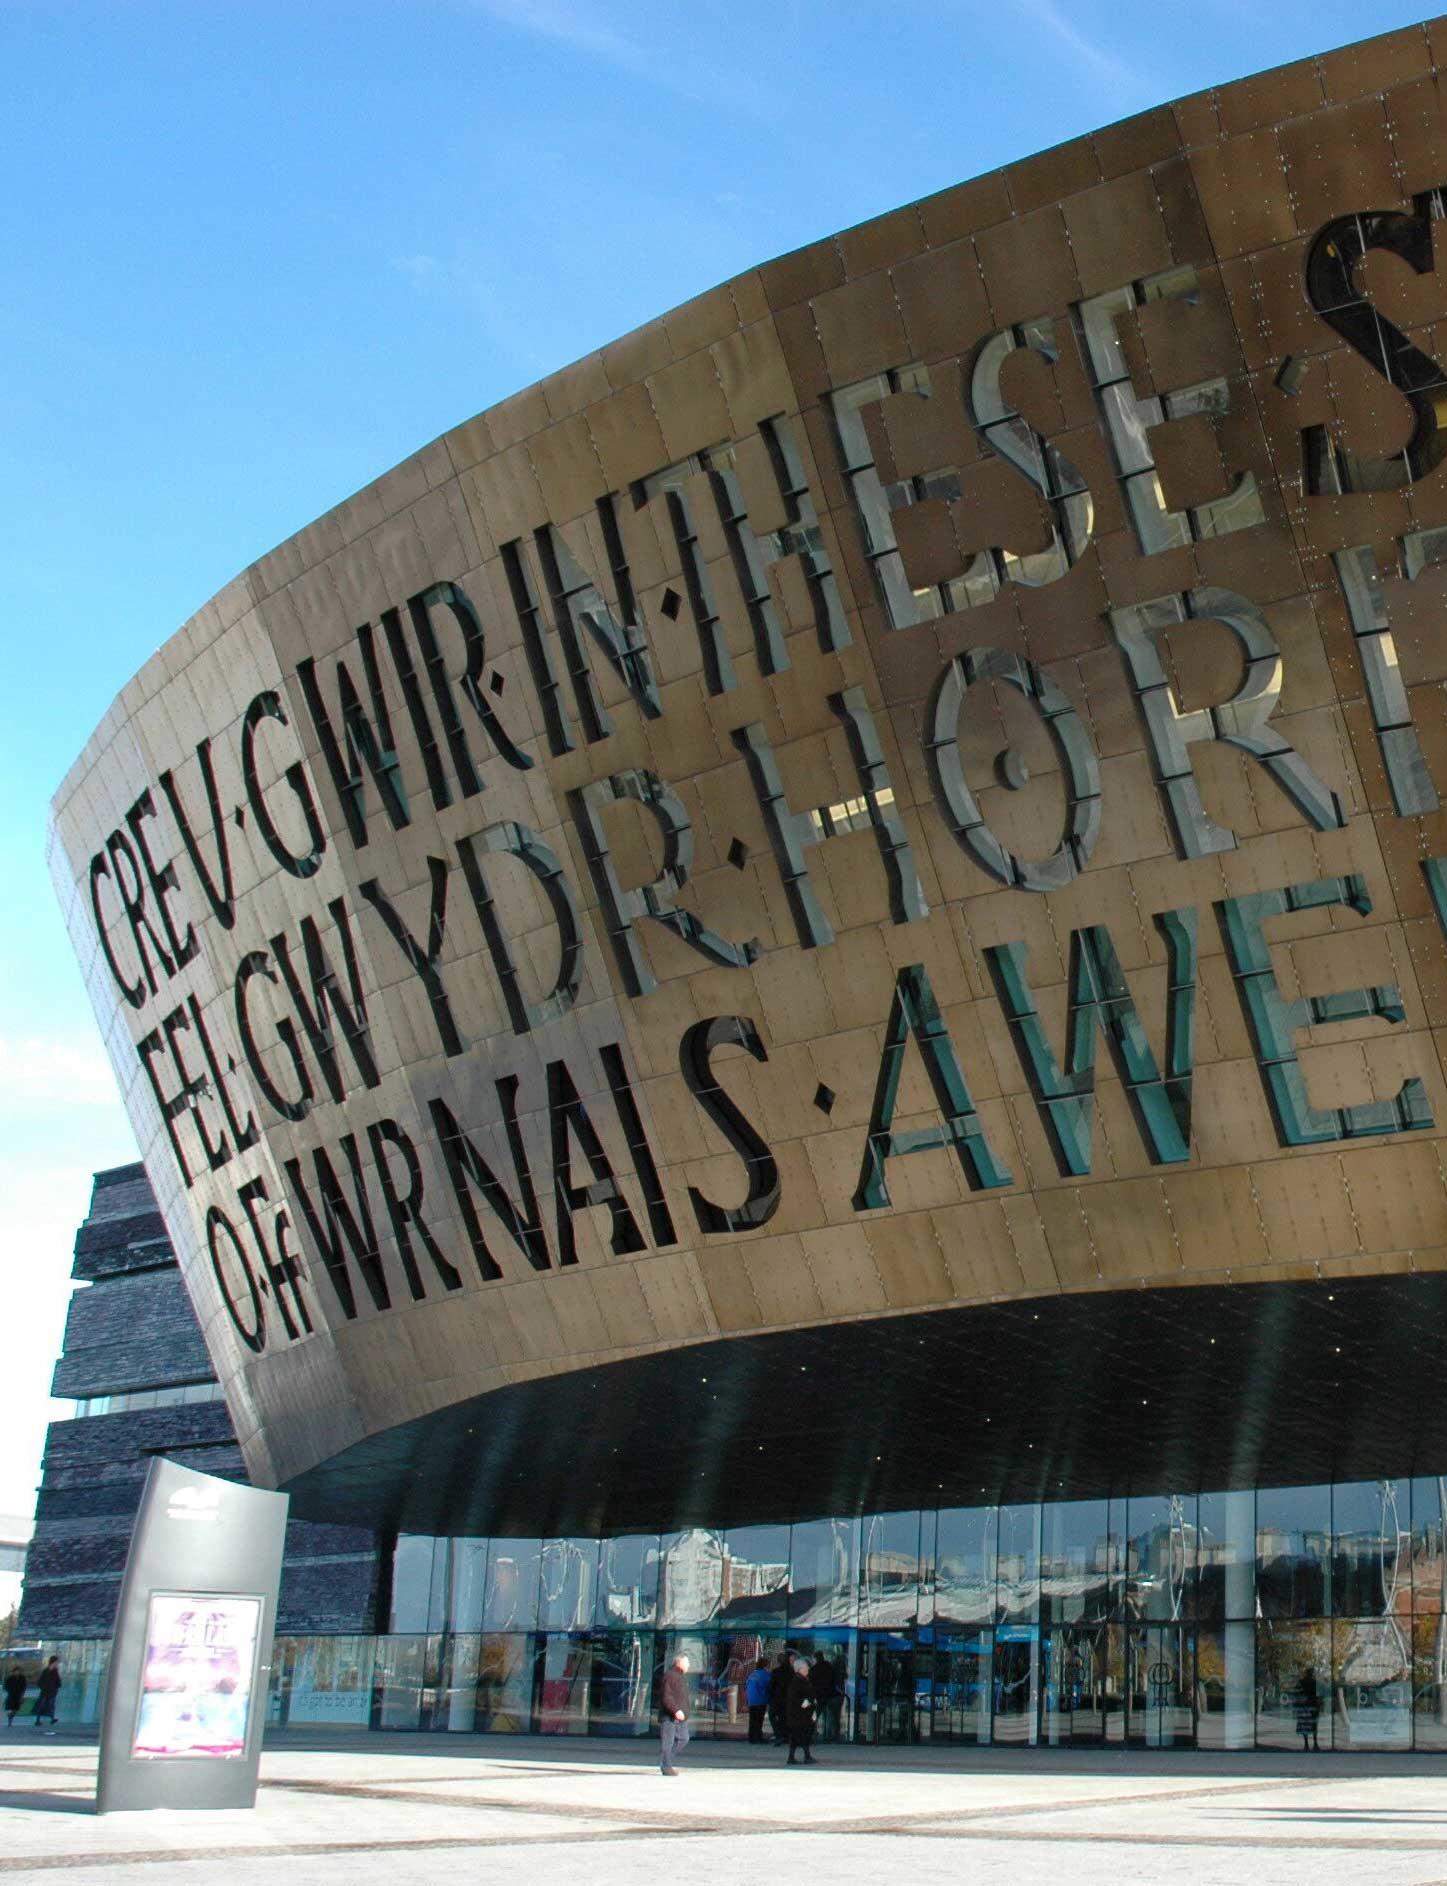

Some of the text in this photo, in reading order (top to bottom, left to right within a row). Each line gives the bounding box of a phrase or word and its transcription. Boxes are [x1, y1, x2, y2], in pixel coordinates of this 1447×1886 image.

[242, 580, 534, 878] GWIR
[499, 491, 664, 757] IN
[631, 263, 1268, 698] THESE
[136, 992, 260, 1189] FEL
[236, 769, 760, 1122] GWYDR
